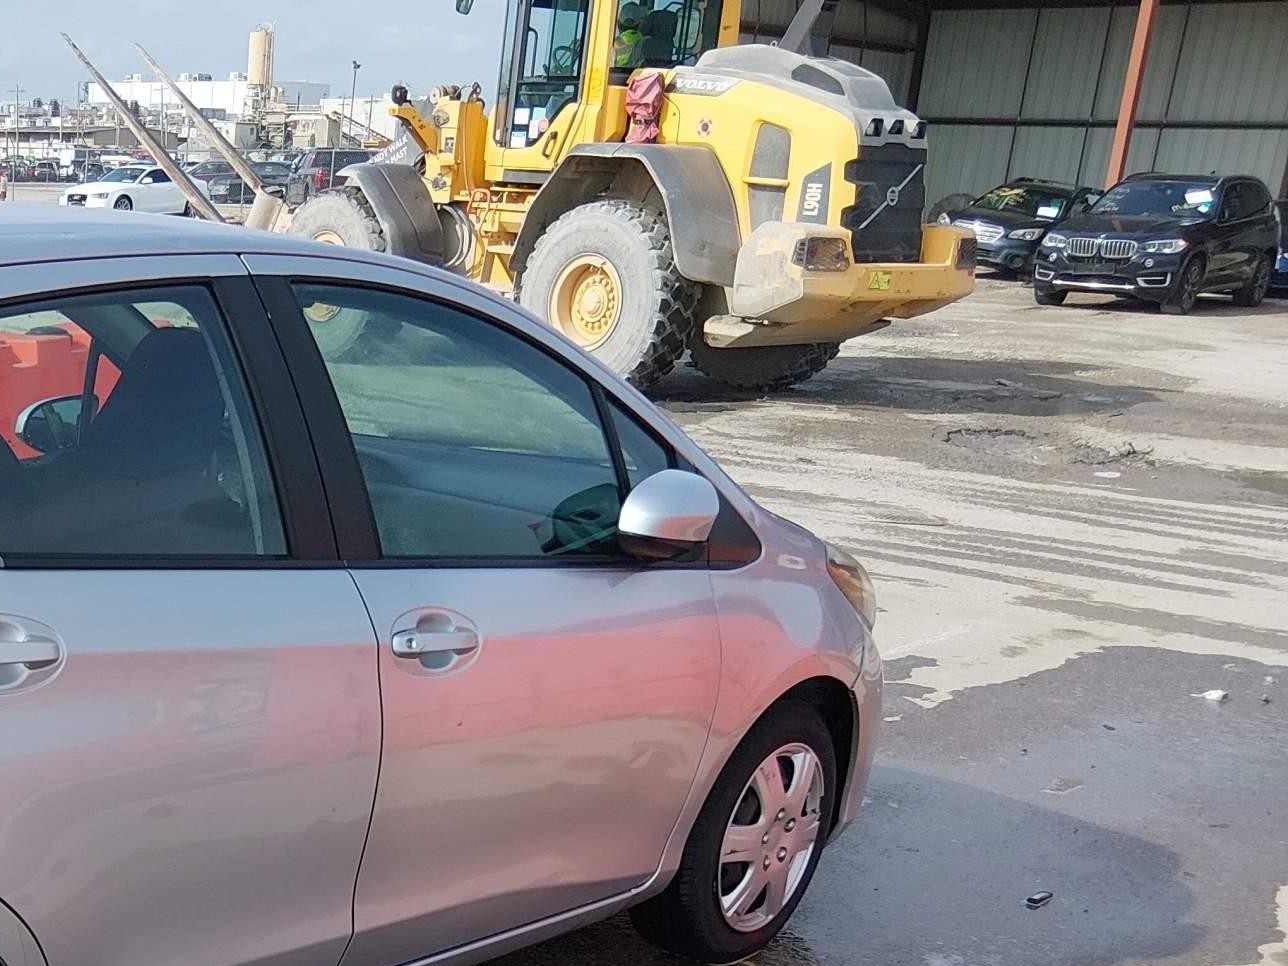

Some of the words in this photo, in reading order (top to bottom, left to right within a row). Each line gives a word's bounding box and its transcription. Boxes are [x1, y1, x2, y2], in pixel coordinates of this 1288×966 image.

[675, 78, 727, 92] VOLVO
[388, 134, 408, 154] WALK
[390, 146, 408, 164] MAST
[802, 183, 824, 216] L90H
